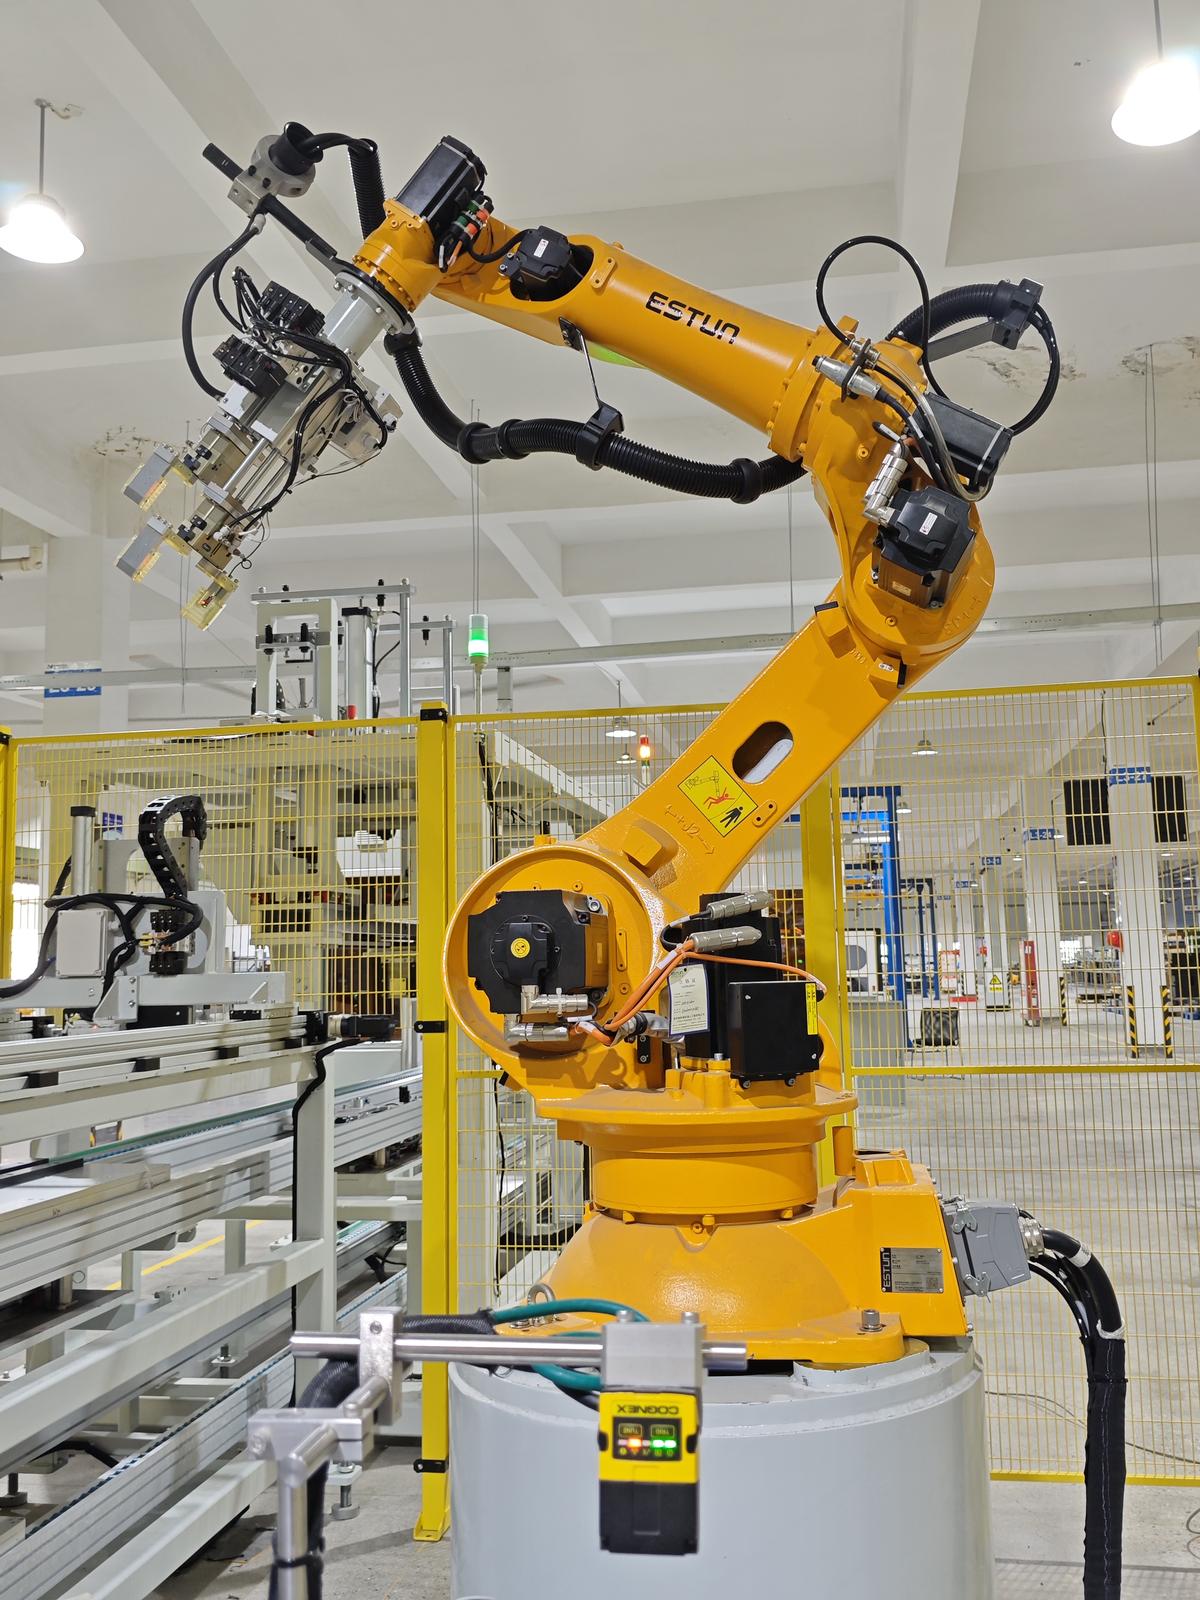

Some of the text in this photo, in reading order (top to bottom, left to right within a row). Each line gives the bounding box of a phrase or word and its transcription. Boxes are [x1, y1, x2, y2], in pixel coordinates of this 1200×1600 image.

[646, 292, 740, 344] ESTUN
[882, 1252, 891, 1287] ESTUN
[617, 1405, 679, 1415] COGNEX
